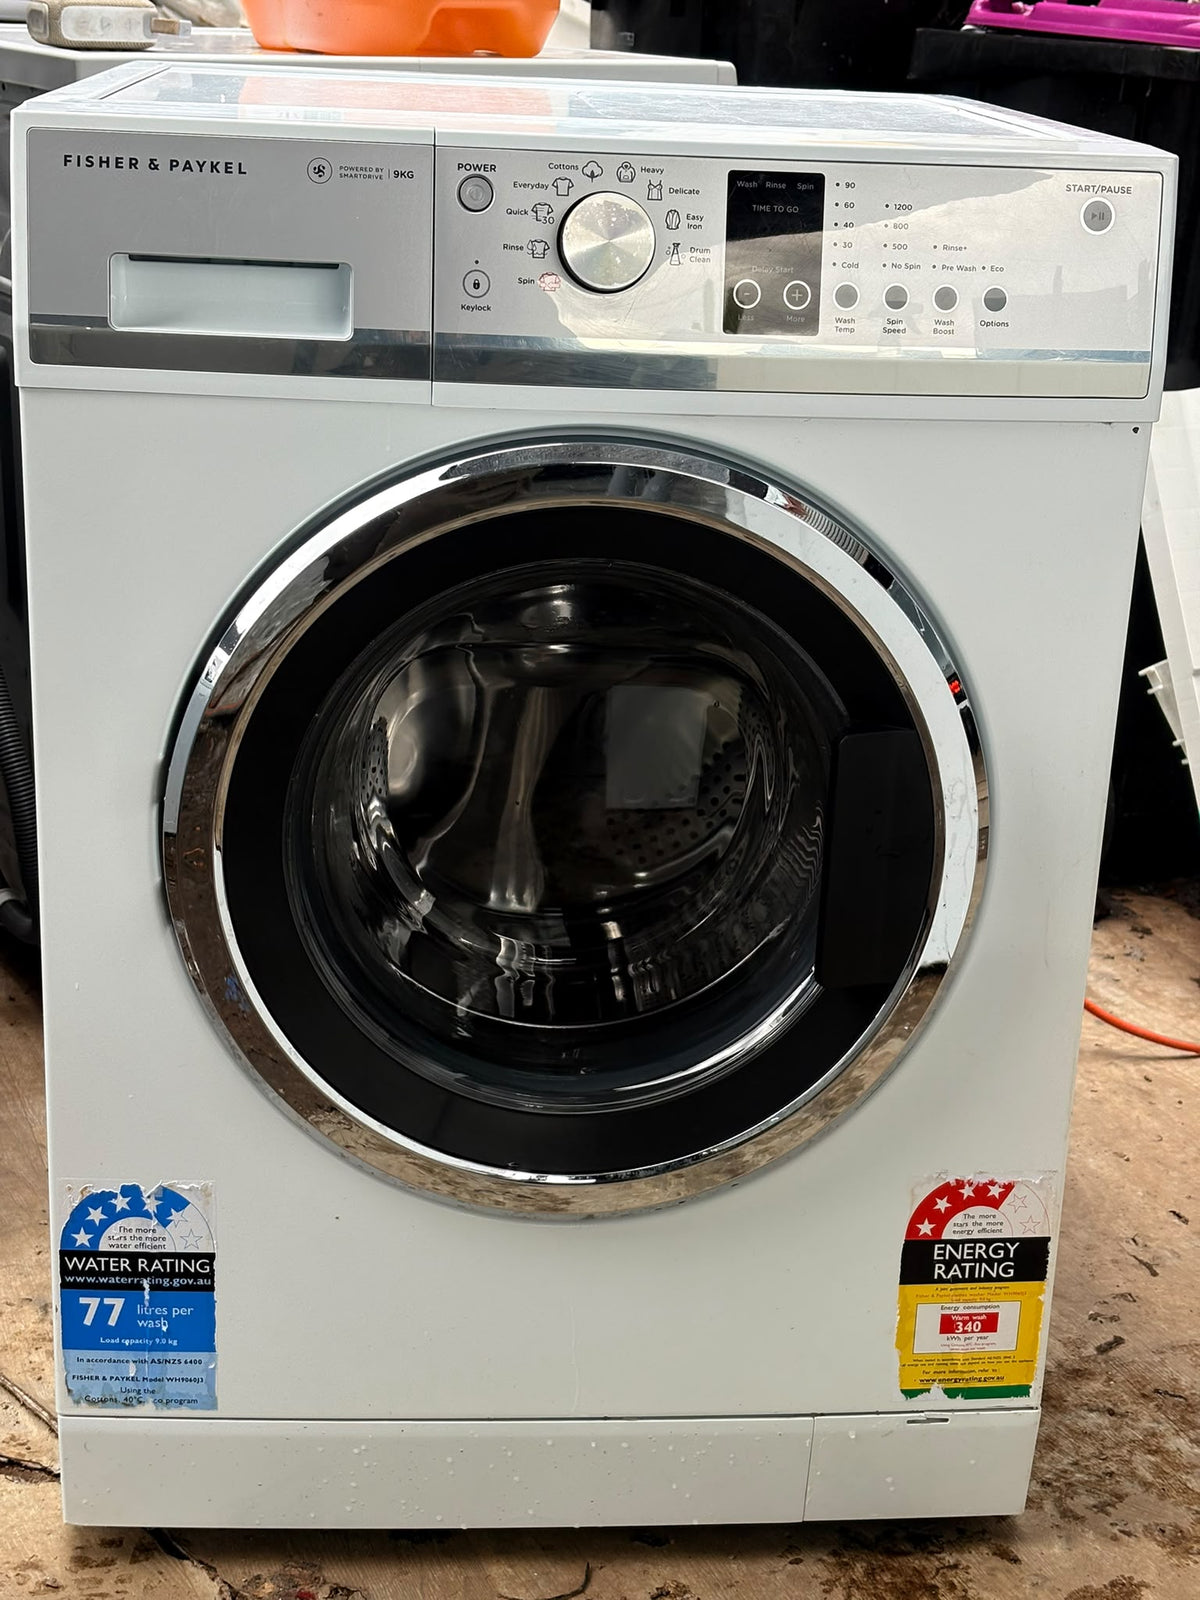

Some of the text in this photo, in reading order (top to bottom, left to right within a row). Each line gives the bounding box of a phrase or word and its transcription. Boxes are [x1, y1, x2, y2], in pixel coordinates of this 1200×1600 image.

[63, 154, 248, 175] FISHER & PAYKEL
[339, 165, 373, 173] POWERED
[457, 163, 497, 172] POWER
[548, 162, 579, 171] Cottons
[393, 169, 415, 180] 9KG
[640, 166, 664, 175] Heavy
[339, 172, 384, 180] SMARTDRIVE
[513, 181, 549, 191] Everyday
[736, 180, 758, 188] Wash
[766, 181, 786, 189] Rinse
[797, 182, 814, 191] Spin
[669, 187, 700, 195] Delicate
[1066, 184, 1132, 194] START/PAUSE
[894, 203, 912, 211] 1200
[506, 208, 529, 216] Quick
[542, 217, 554, 225] 30
[686, 214, 704, 223] Easy
[893, 222, 908, 230] 800
[842, 261, 859, 269] Cold
[892, 262, 921, 272] No Spin
[942, 264, 976, 272] Pre Wash
[518, 277, 535, 286] Spin
[461, 304, 491, 312] Keylock
[886, 318, 904, 326] Spin
[980, 320, 1009, 328] Options
[834, 326, 855, 334] Temp
[882, 326, 906, 335] Speed
[933, 327, 954, 335] Boost
[134, 1242, 166, 1250] efficient
[934, 1242, 1020, 1260] ENERGY
[65, 1256, 210, 1273] WATER RATING
[934, 1262, 1015, 1279] RATING
[64, 1275, 211, 1286] www.waterrating.gov.au
[79, 1297, 125, 1326] 77
[137, 1304, 194, 1317] litres per
[137, 1317, 168, 1329] wash
[955, 1321, 981, 1333] 340
[120, 1387, 141, 1395] Using
